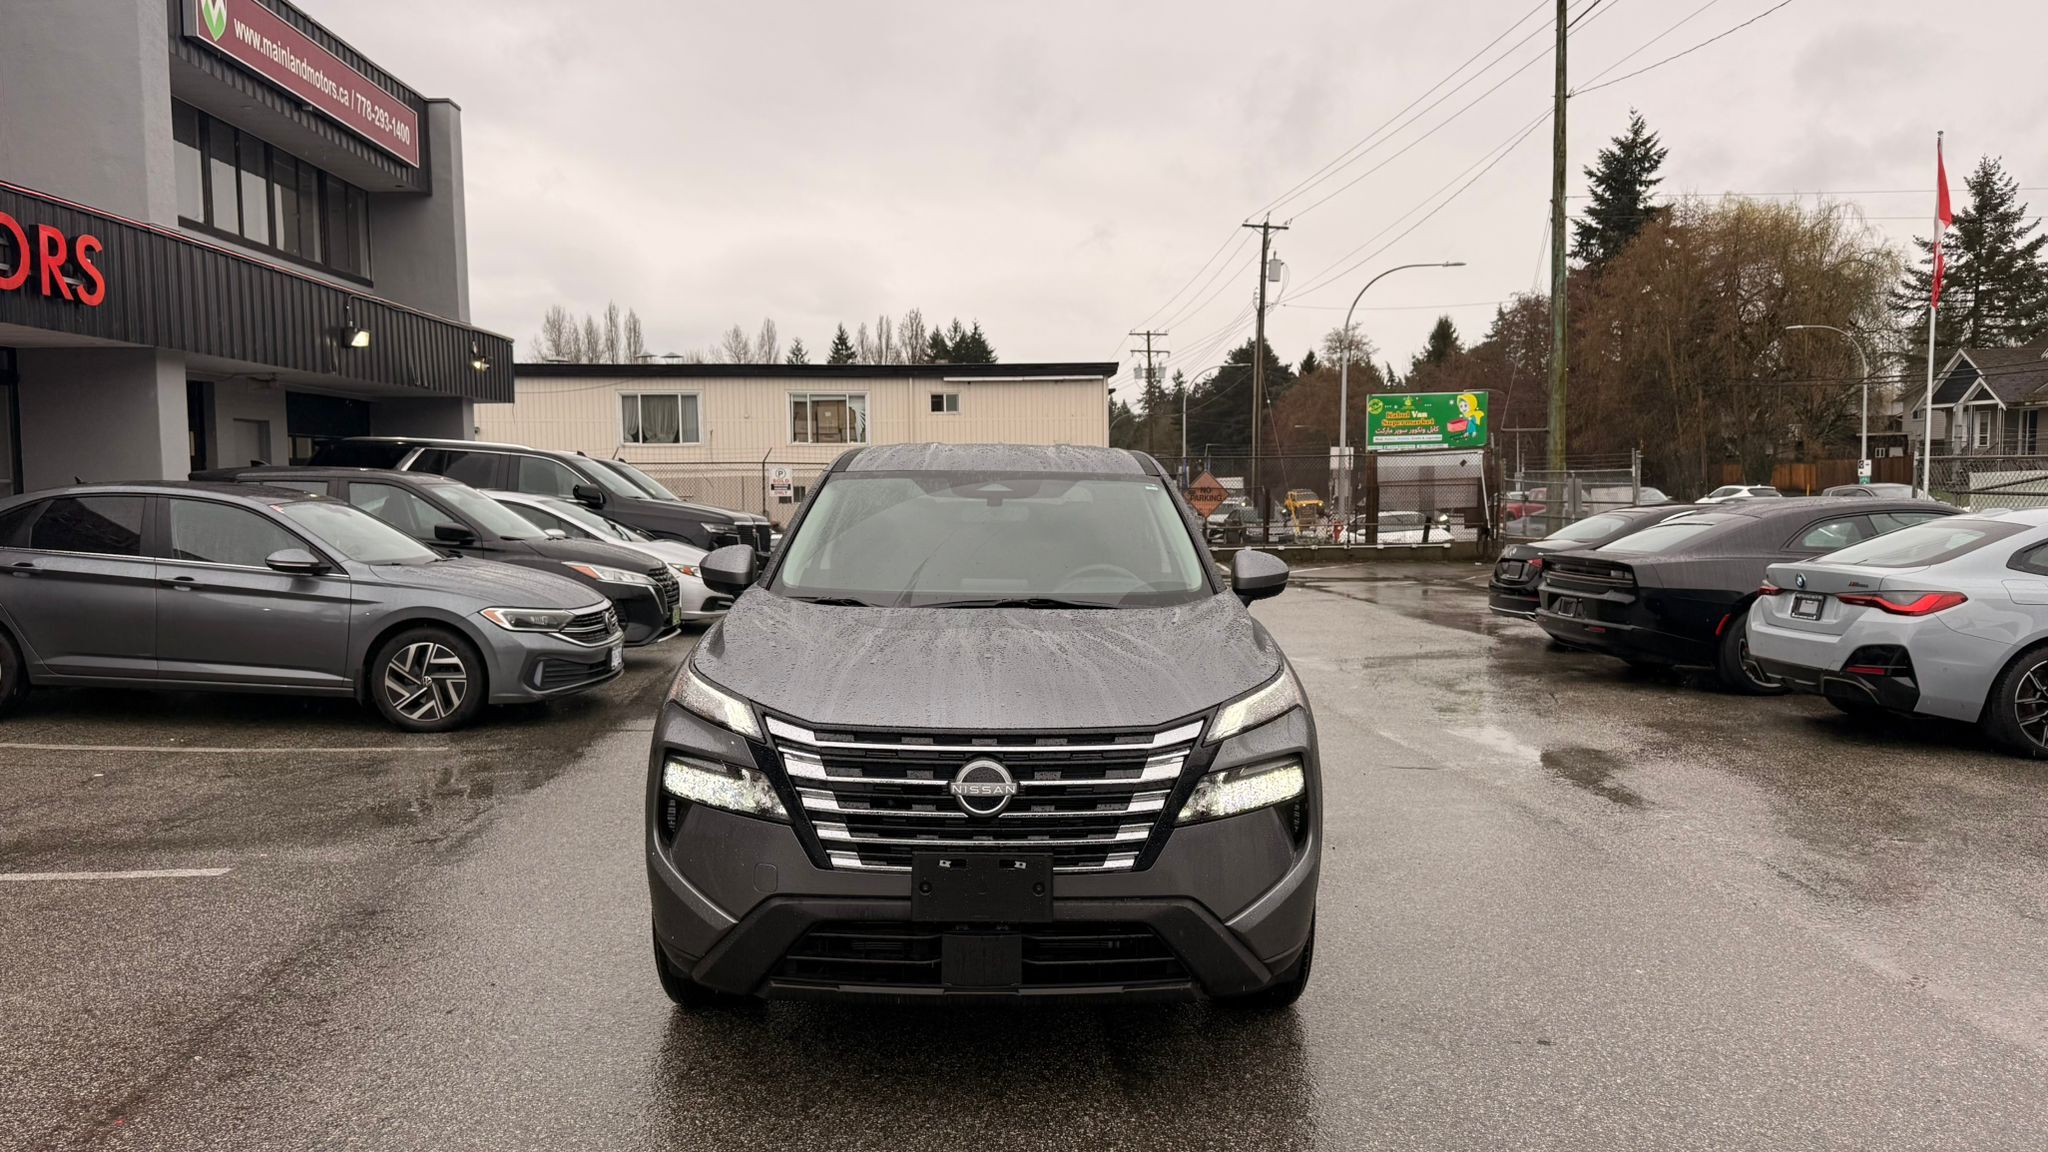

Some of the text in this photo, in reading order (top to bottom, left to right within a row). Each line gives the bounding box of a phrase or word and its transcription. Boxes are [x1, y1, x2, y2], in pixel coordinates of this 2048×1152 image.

[233, 18, 349, 107] www.mainlandmotors.ca
[356, 93, 410, 146] 778-293-1400
[1382, 418, 1434, 427] Supermarket
[952, 785, 1015, 794] NISSAN
